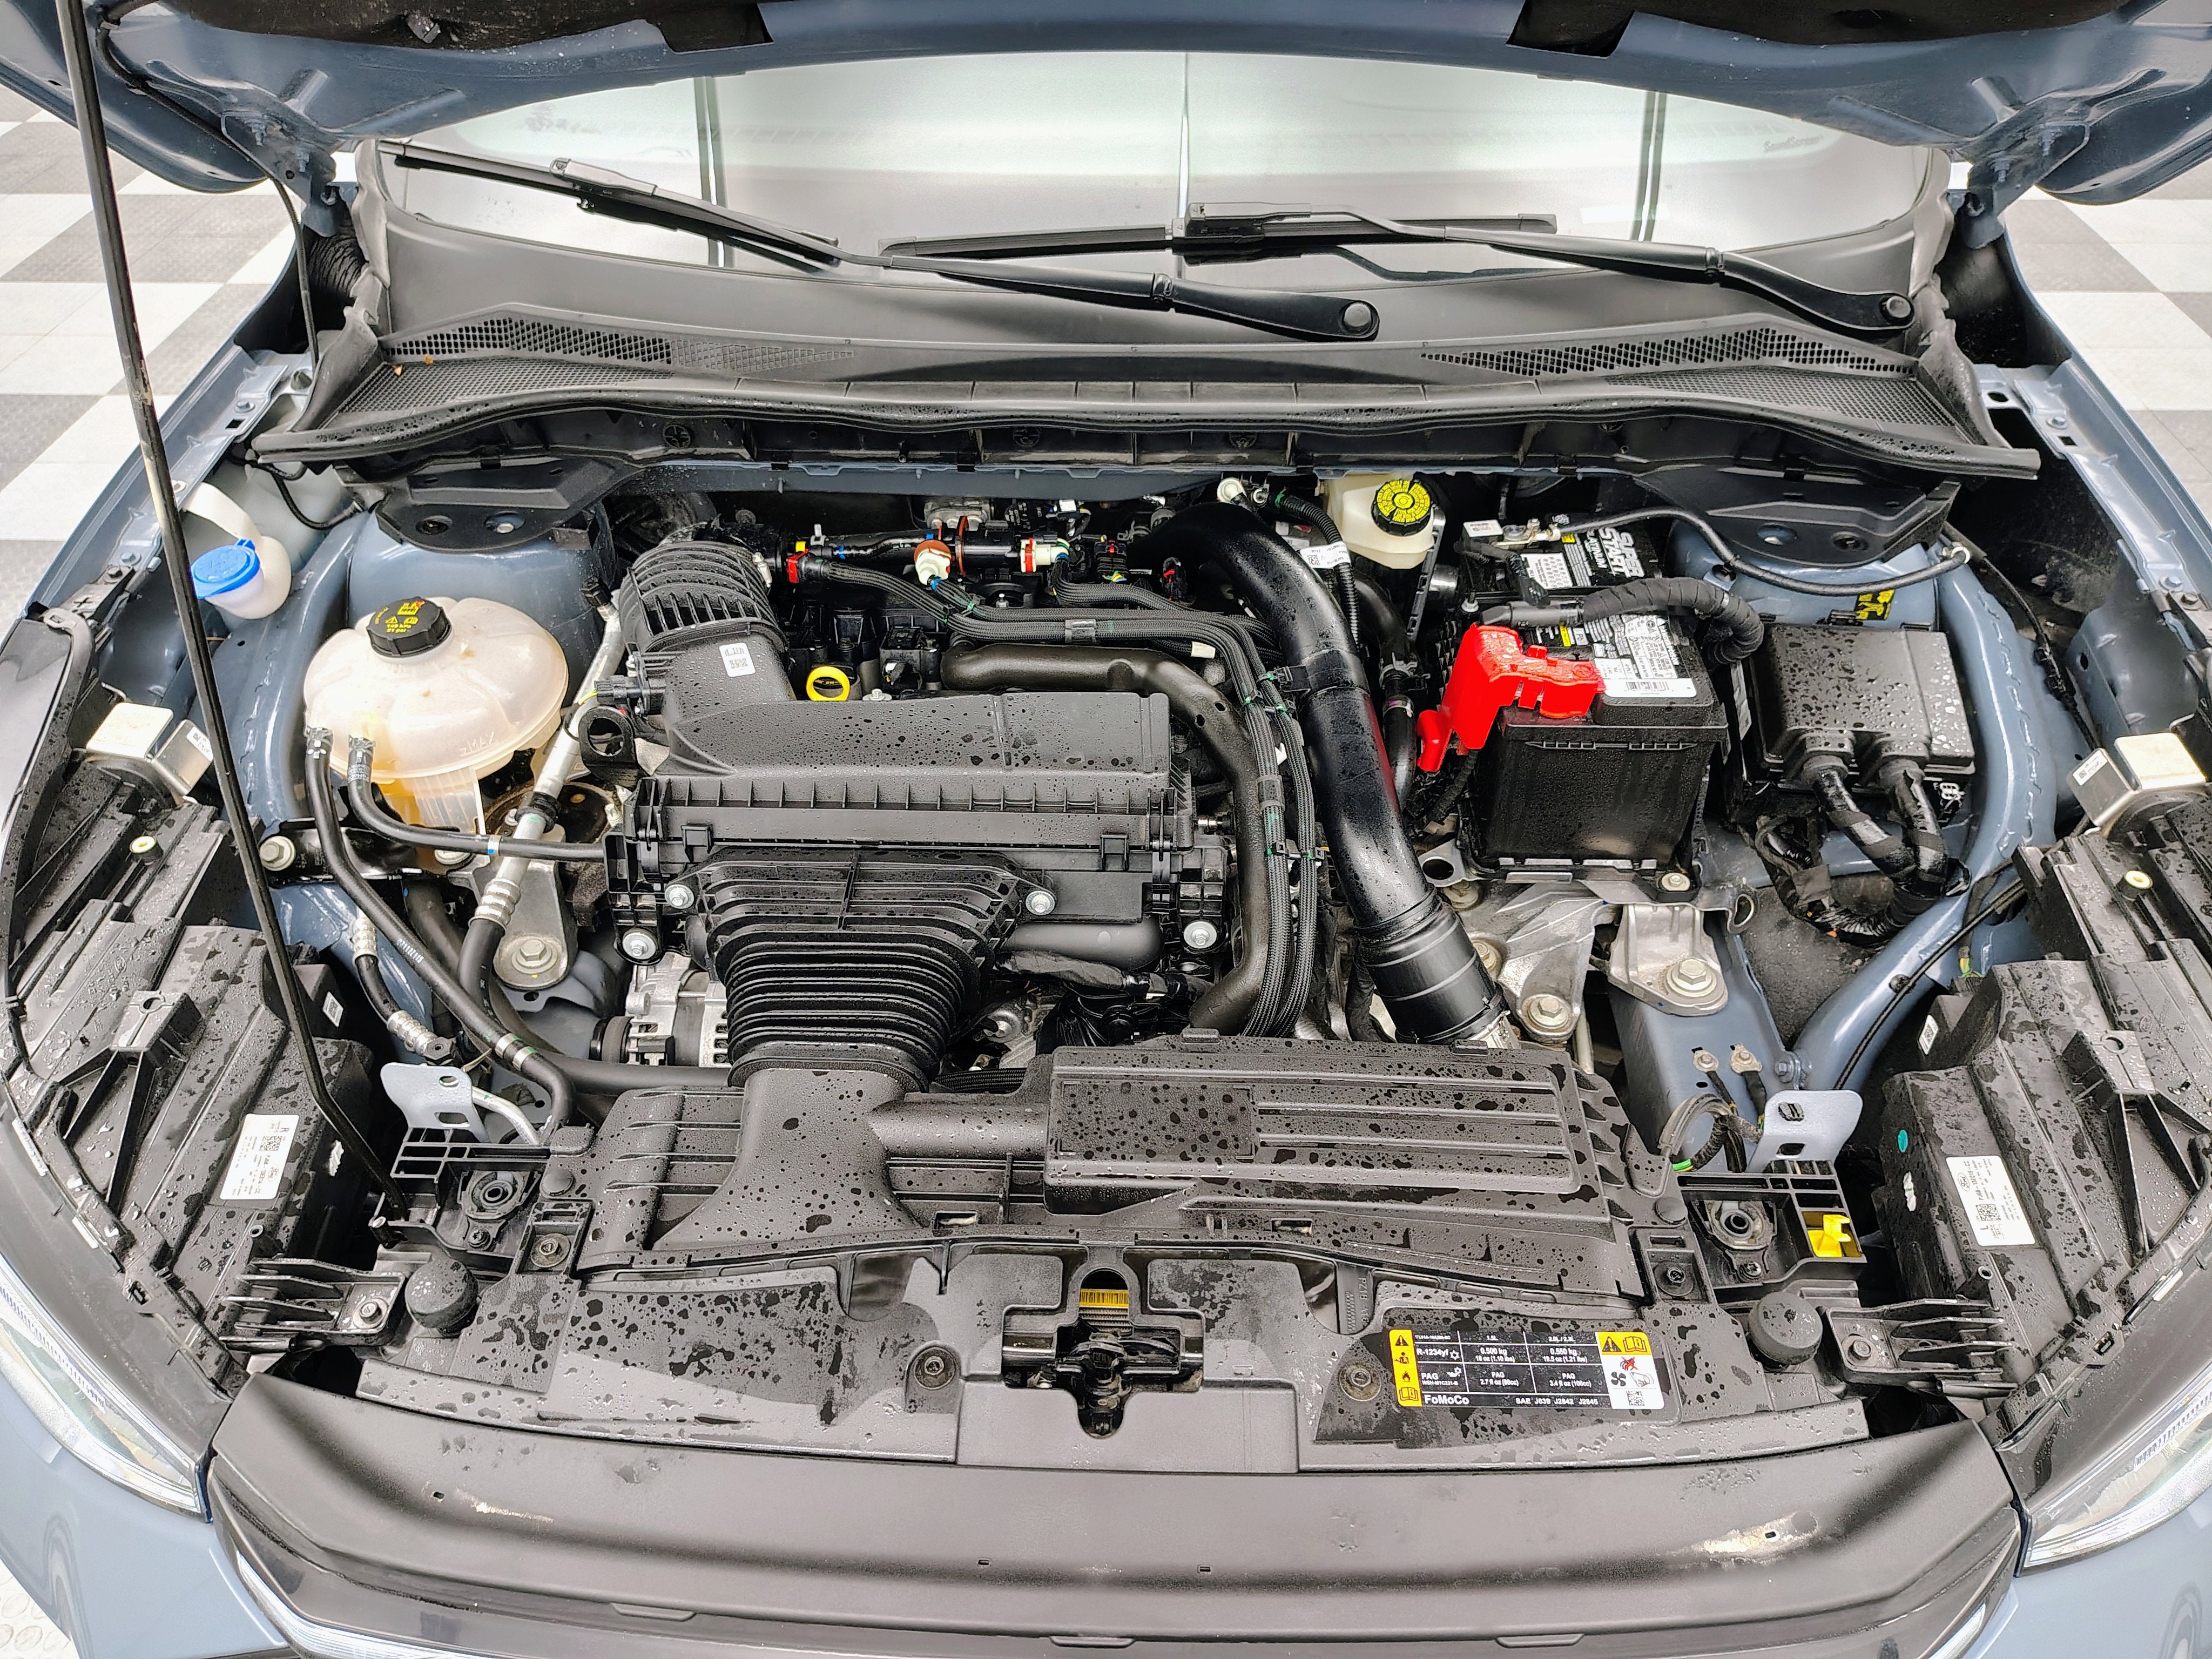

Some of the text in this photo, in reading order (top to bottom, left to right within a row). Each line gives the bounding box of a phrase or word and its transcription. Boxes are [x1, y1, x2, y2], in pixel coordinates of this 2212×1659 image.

[1599, 528, 1631, 578] START
[1620, 532, 1645, 577] SUPER
[1417, 1348, 1448, 1357] R-1234yf
[1499, 1347, 1507, 1356] kg
[1569, 1348, 1577, 1357] kg
[1424, 1394, 1469, 1405] FoMoCo
